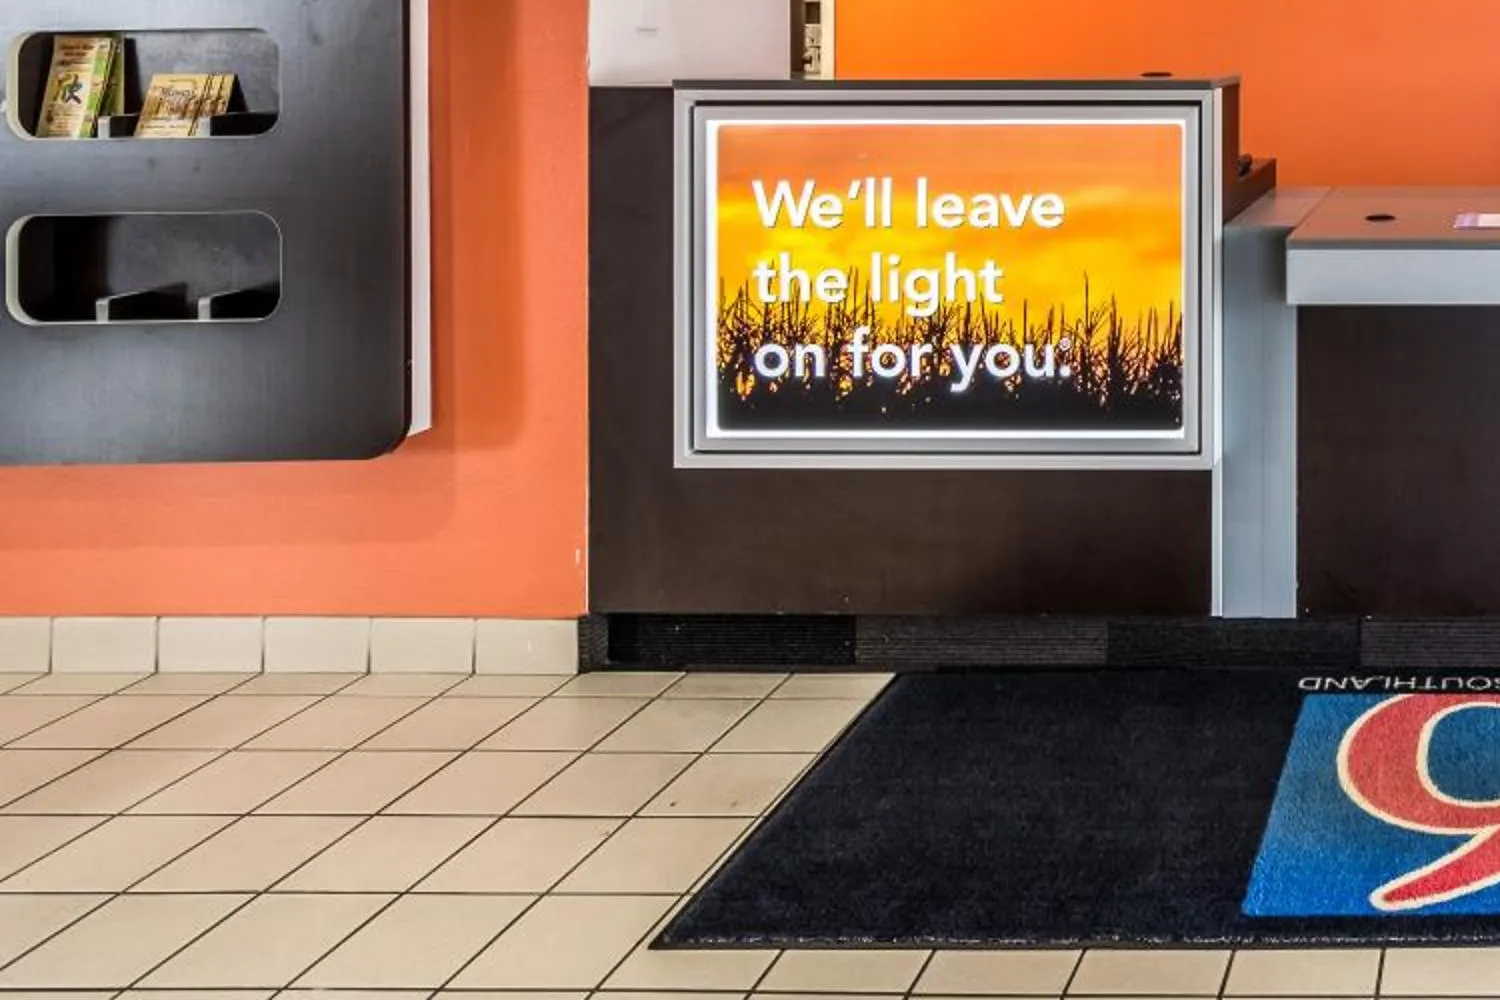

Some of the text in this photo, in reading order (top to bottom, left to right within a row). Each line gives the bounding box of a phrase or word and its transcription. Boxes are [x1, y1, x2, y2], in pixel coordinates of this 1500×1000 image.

[752, 176, 1066, 229] We'll leave
[752, 251, 1004, 317] the light
[753, 342, 827, 379] on
[847, 326, 934, 379] for
